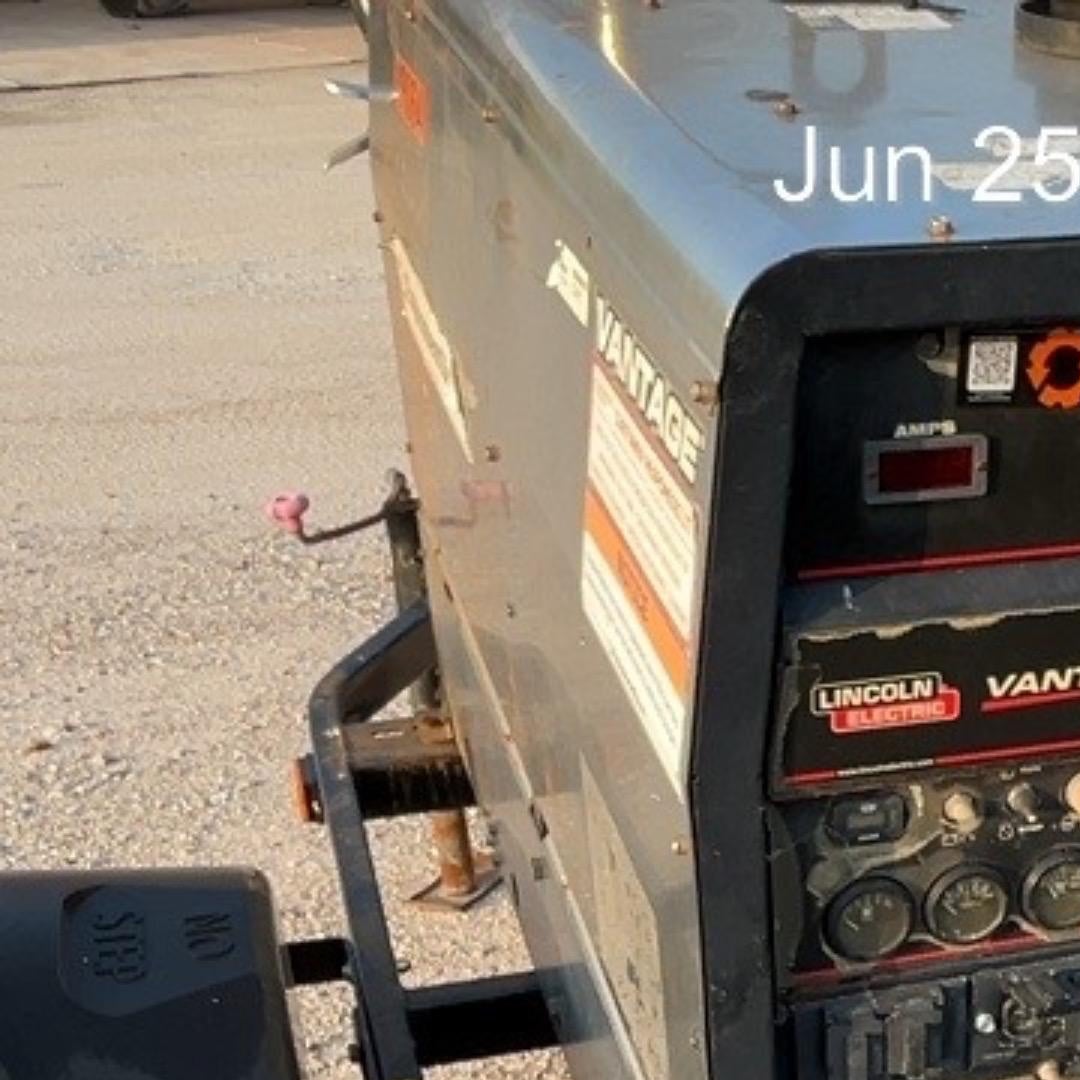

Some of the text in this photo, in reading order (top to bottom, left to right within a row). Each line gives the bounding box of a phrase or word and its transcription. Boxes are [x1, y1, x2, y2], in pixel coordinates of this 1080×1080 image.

[595, 294, 706, 484] VANTAGE
[893, 420, 958, 439] AMPS
[819, 679, 934, 710] LINCOLN
[846, 700, 946, 728] ELECTRIC
[92, 910, 148, 985] STEP
[184, 912, 236, 962] NO
